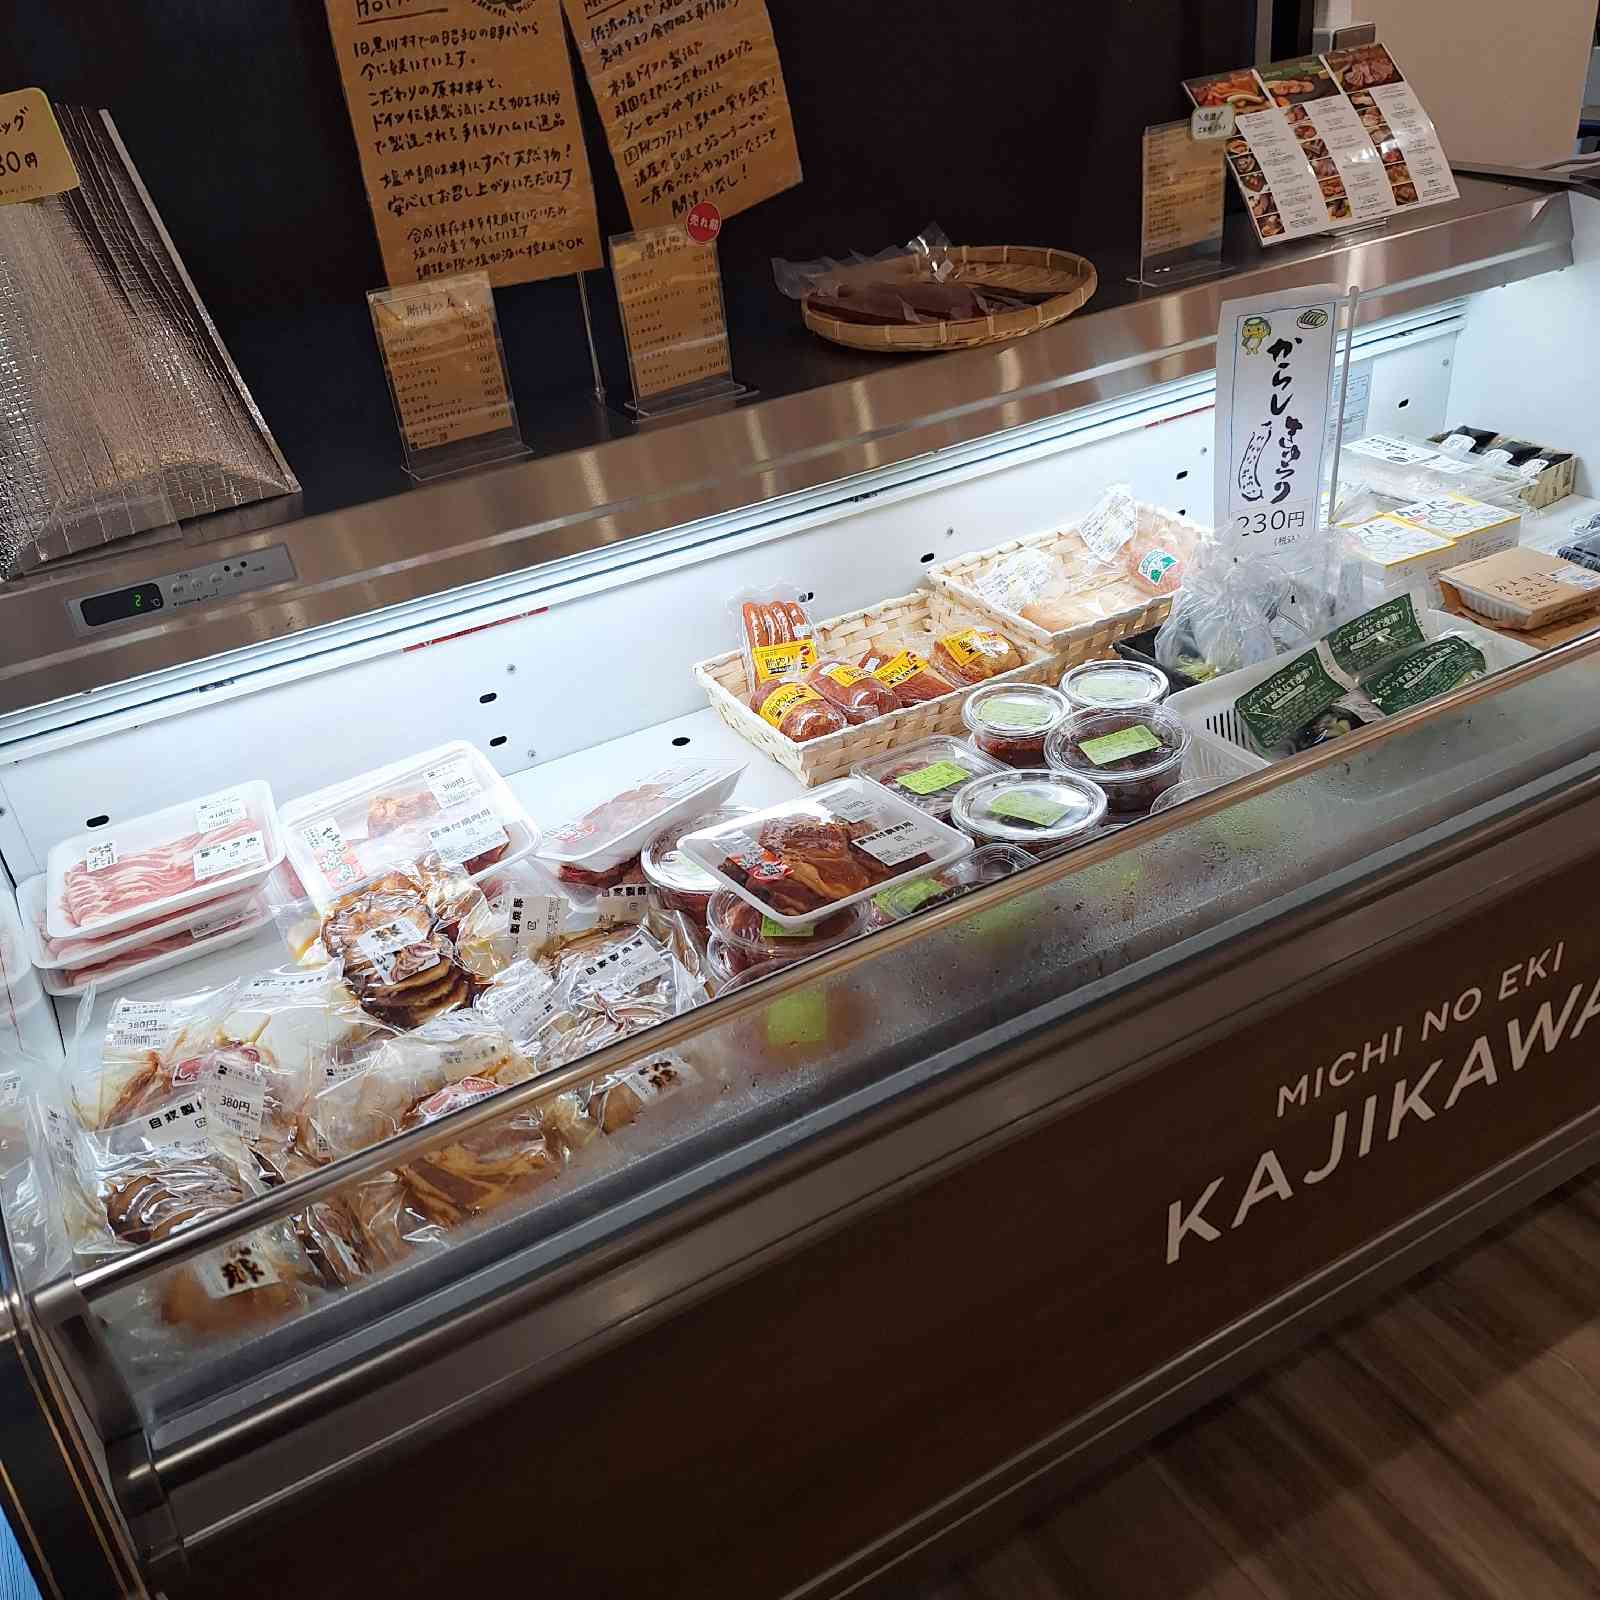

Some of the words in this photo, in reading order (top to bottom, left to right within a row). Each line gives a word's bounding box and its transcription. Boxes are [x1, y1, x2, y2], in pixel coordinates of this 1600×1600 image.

[1237, 509, 1305, 537] 230円
[1276, 1026, 1404, 1118] MICHI
[1421, 987, 1482, 1042] NO
[1498, 941, 1566, 1001] EKI
[219, 1094, 252, 1113] 380円
